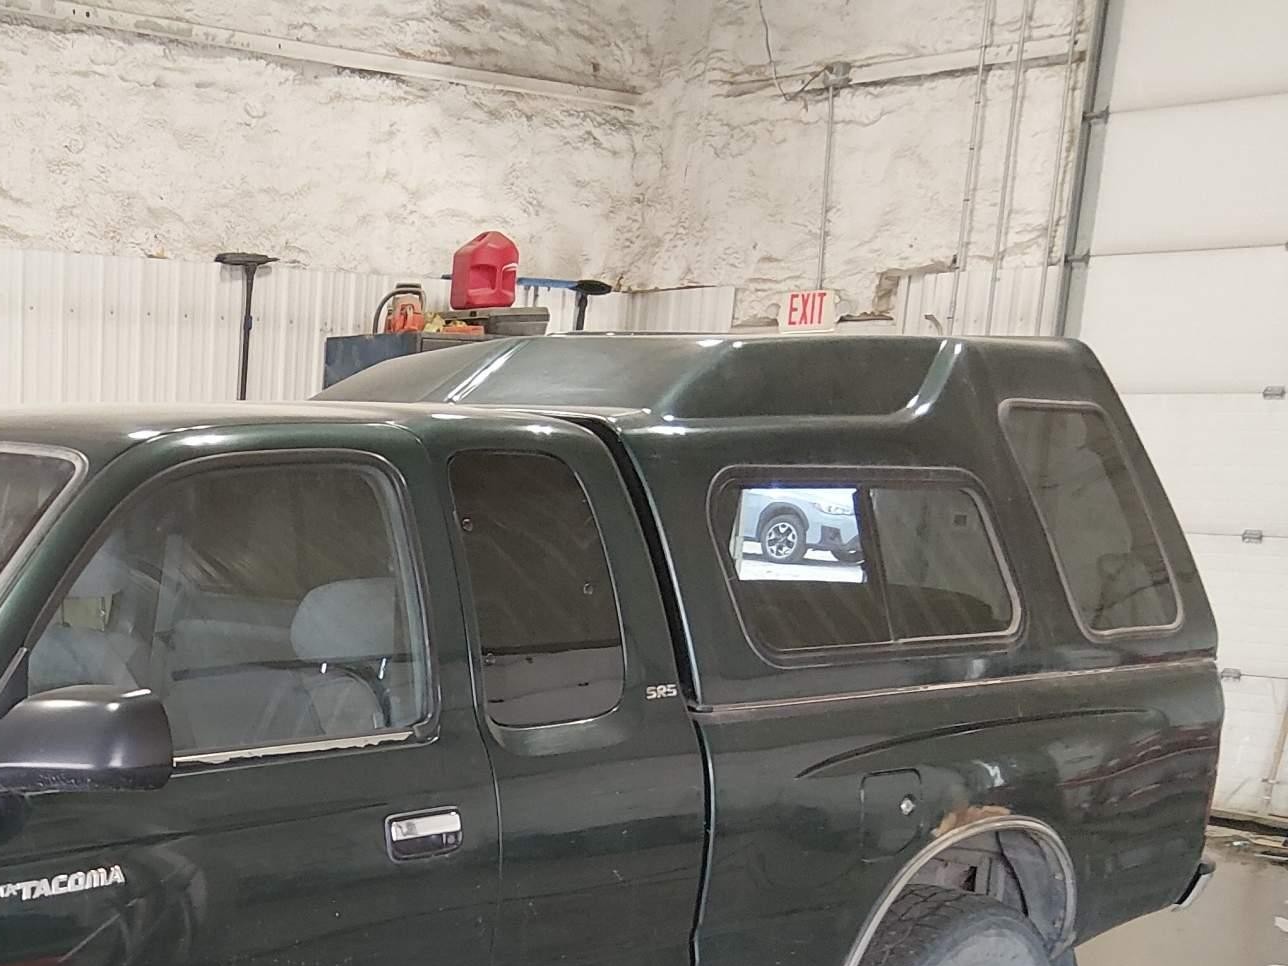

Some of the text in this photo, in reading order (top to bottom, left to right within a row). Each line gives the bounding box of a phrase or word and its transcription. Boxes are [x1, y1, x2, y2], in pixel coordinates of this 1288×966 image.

[788, 292, 827, 326] EXIT
[646, 684, 678, 700] SR5
[16, 864, 126, 901] TACOMA
